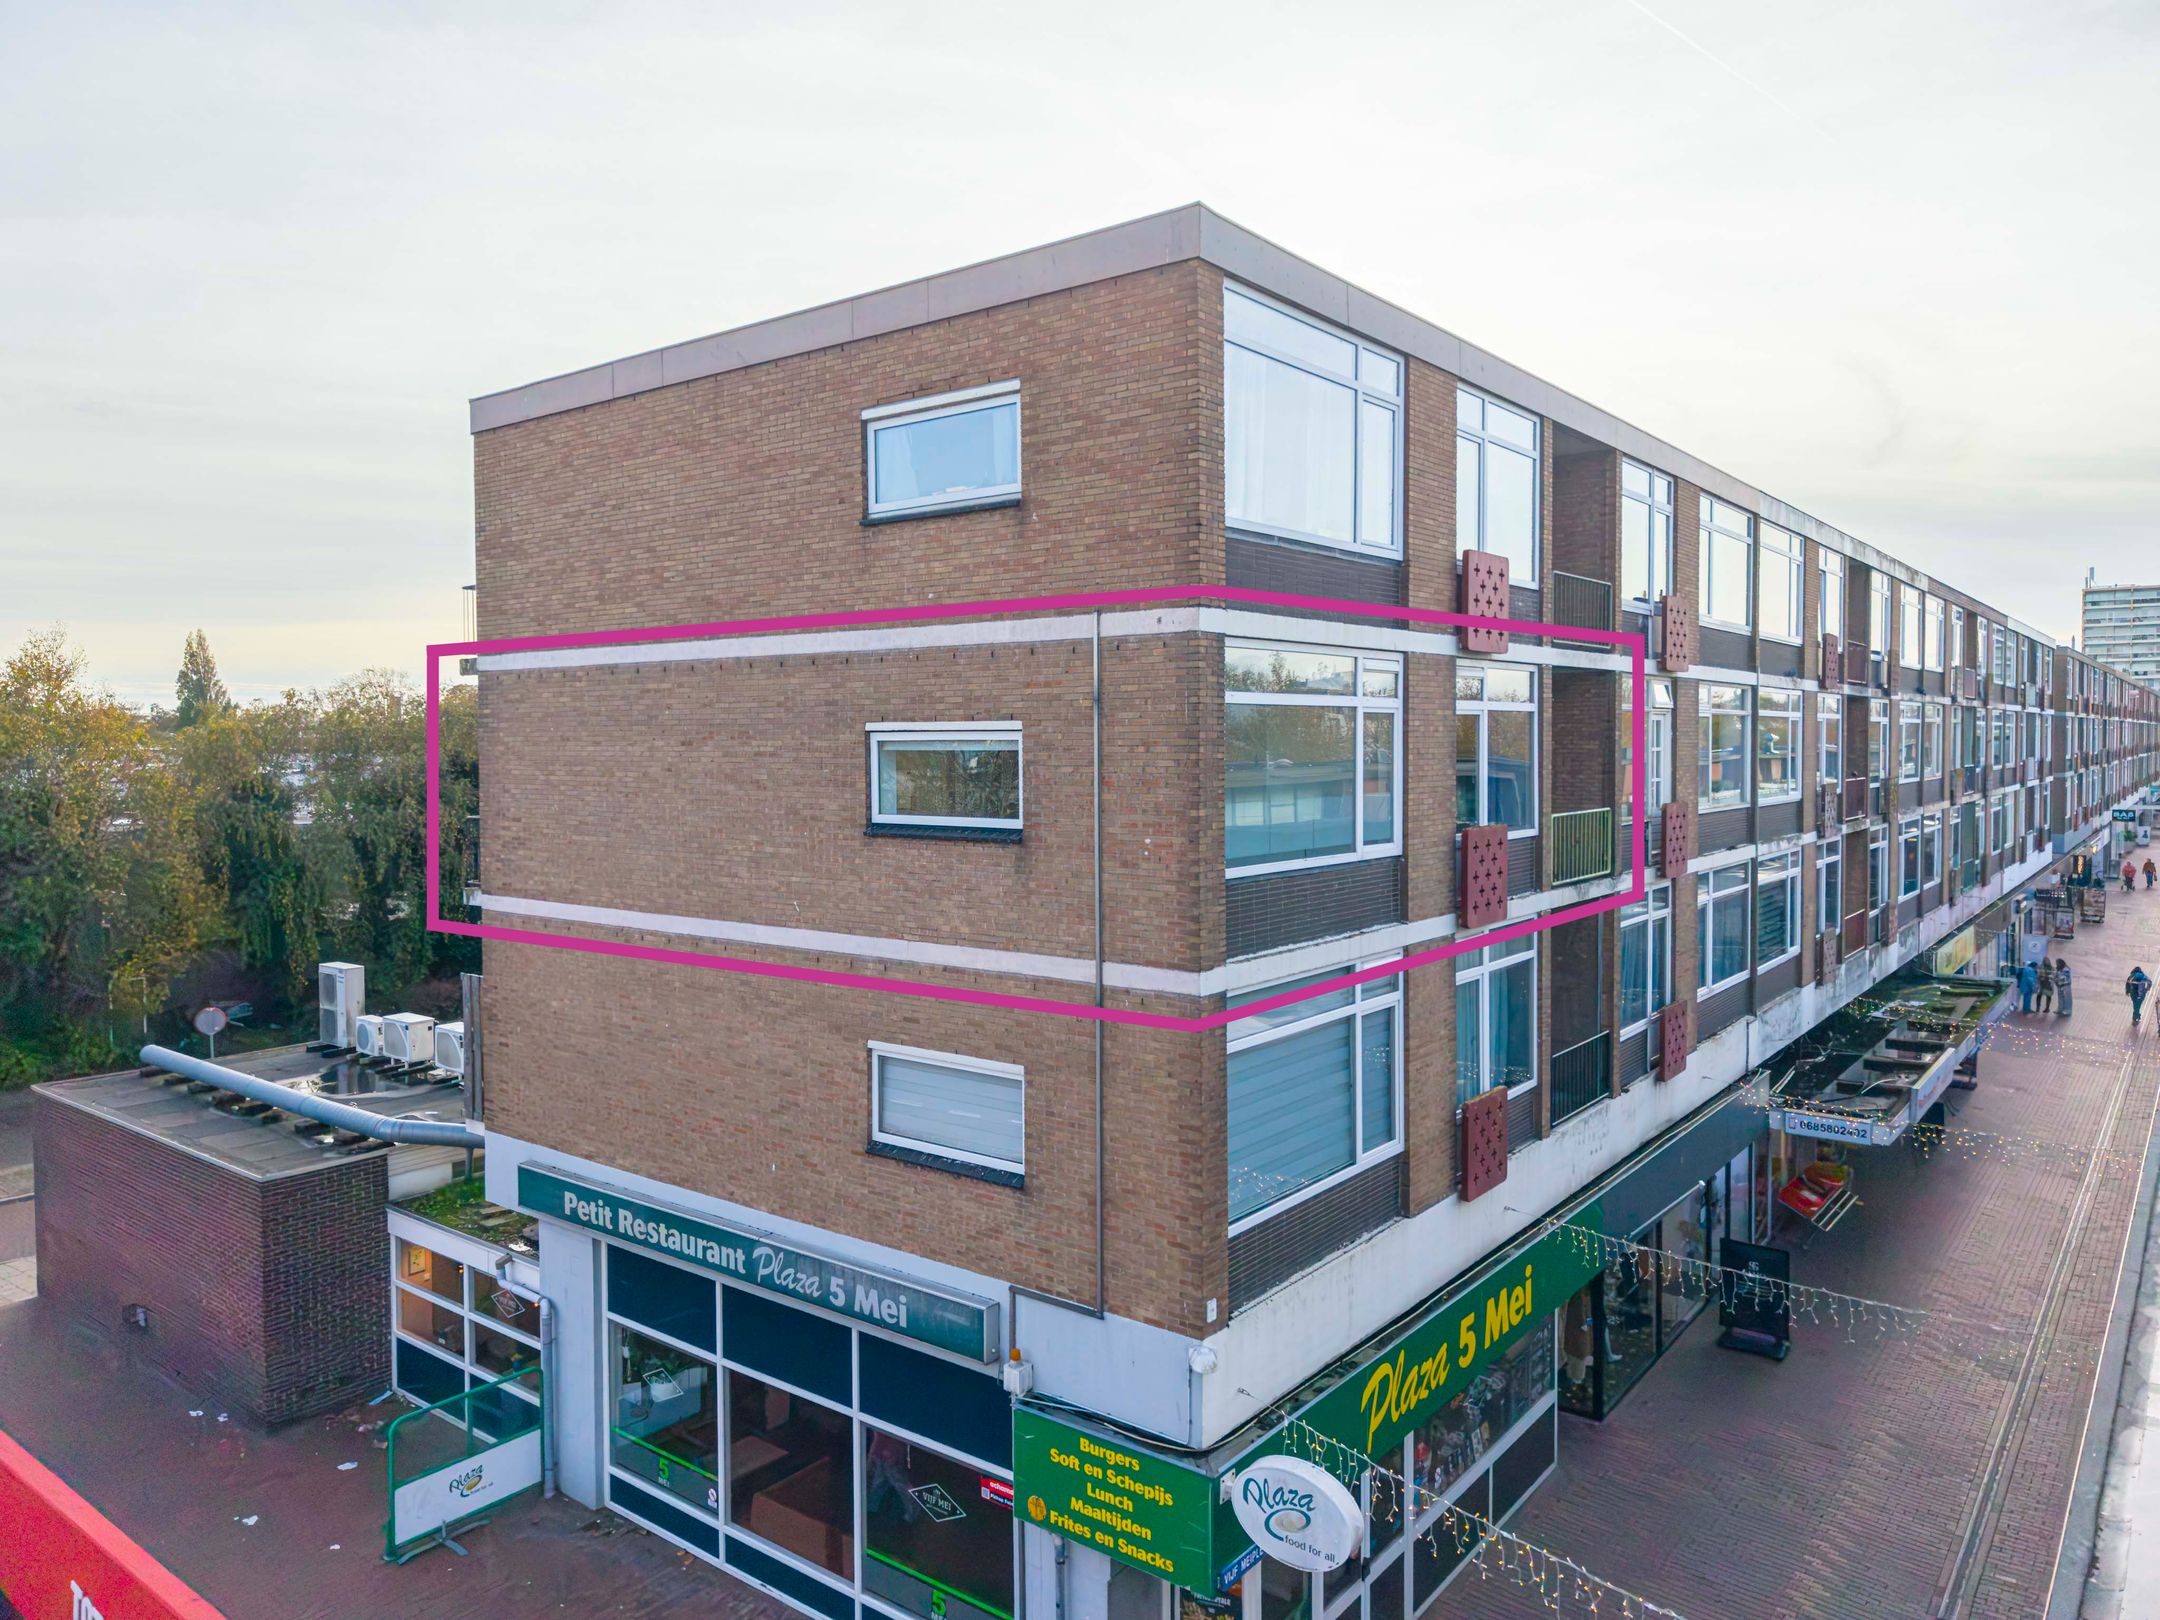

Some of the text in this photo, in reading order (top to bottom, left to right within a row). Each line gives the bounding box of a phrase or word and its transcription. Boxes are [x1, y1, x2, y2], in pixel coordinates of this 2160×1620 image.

[564, 1191, 907, 1328] Petit Restaurant Plaza 5 Mei
[1360, 1264, 1532, 1454] Plaza 5 Mei
[658, 1457, 669, 1479] 5
[1079, 1437, 1140, 1471] Burgers
[449, 1465, 483, 1493] Plaza
[1050, 1448, 1174, 1506] Soft en Schepijs
[938, 1498, 951, 1511] MEI
[1086, 1482, 1133, 1512] Lunch
[1243, 1477, 1316, 1514] Plaza
[1070, 1497, 1151, 1540] Maaltijden
[1050, 1510, 1174, 1573] Frites en Snacks
[1284, 1535, 1335, 1563] food for all
[1224, 1565, 1238, 1584] VIJF
[931, 1590, 946, 1616] 5
